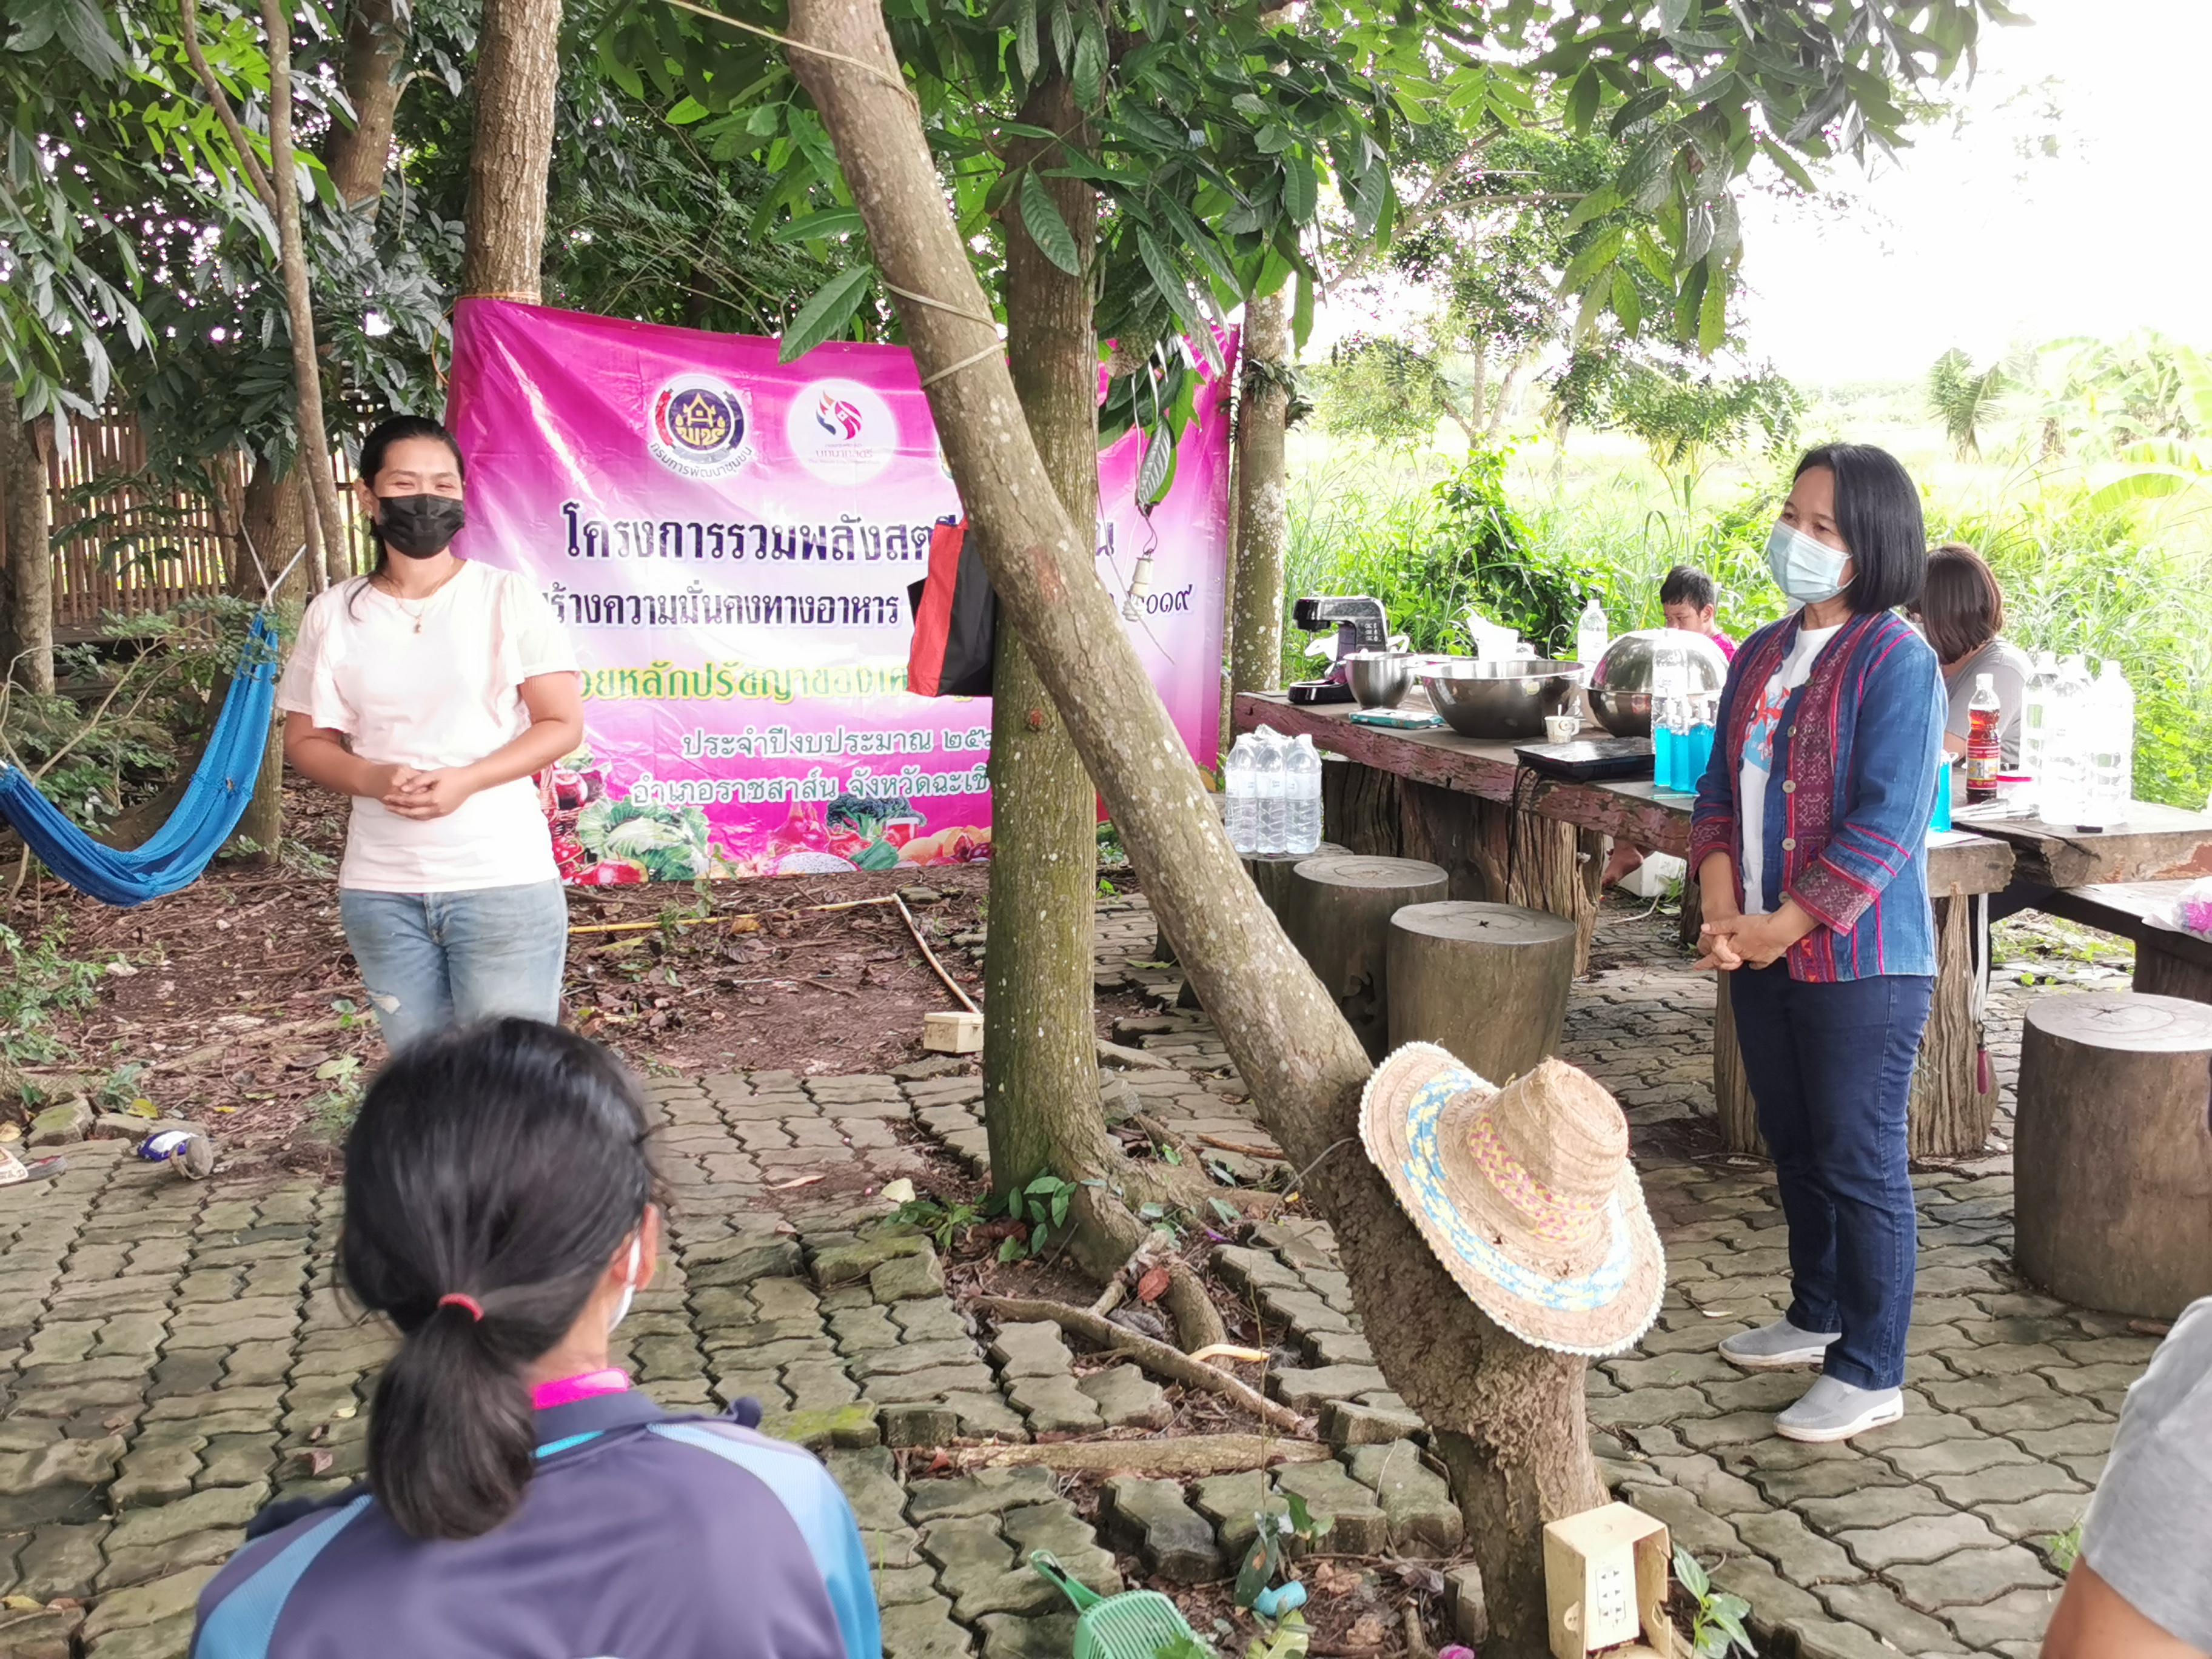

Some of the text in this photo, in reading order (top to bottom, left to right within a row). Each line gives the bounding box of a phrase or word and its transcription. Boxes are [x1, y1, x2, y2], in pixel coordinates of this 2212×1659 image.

[650, 443, 752, 477] กรมการพัฒนาชุมชน
[563, 501, 956, 561] โครงการรวมพลังสตี
[542, 580, 1193, 625] ร้างความมั่นคงทางอาหาร ๐๑๙
[683, 727, 931, 754] ประจำปีงบประมาณ
[634, 769, 836, 803] อำเภอราชสาส์น
